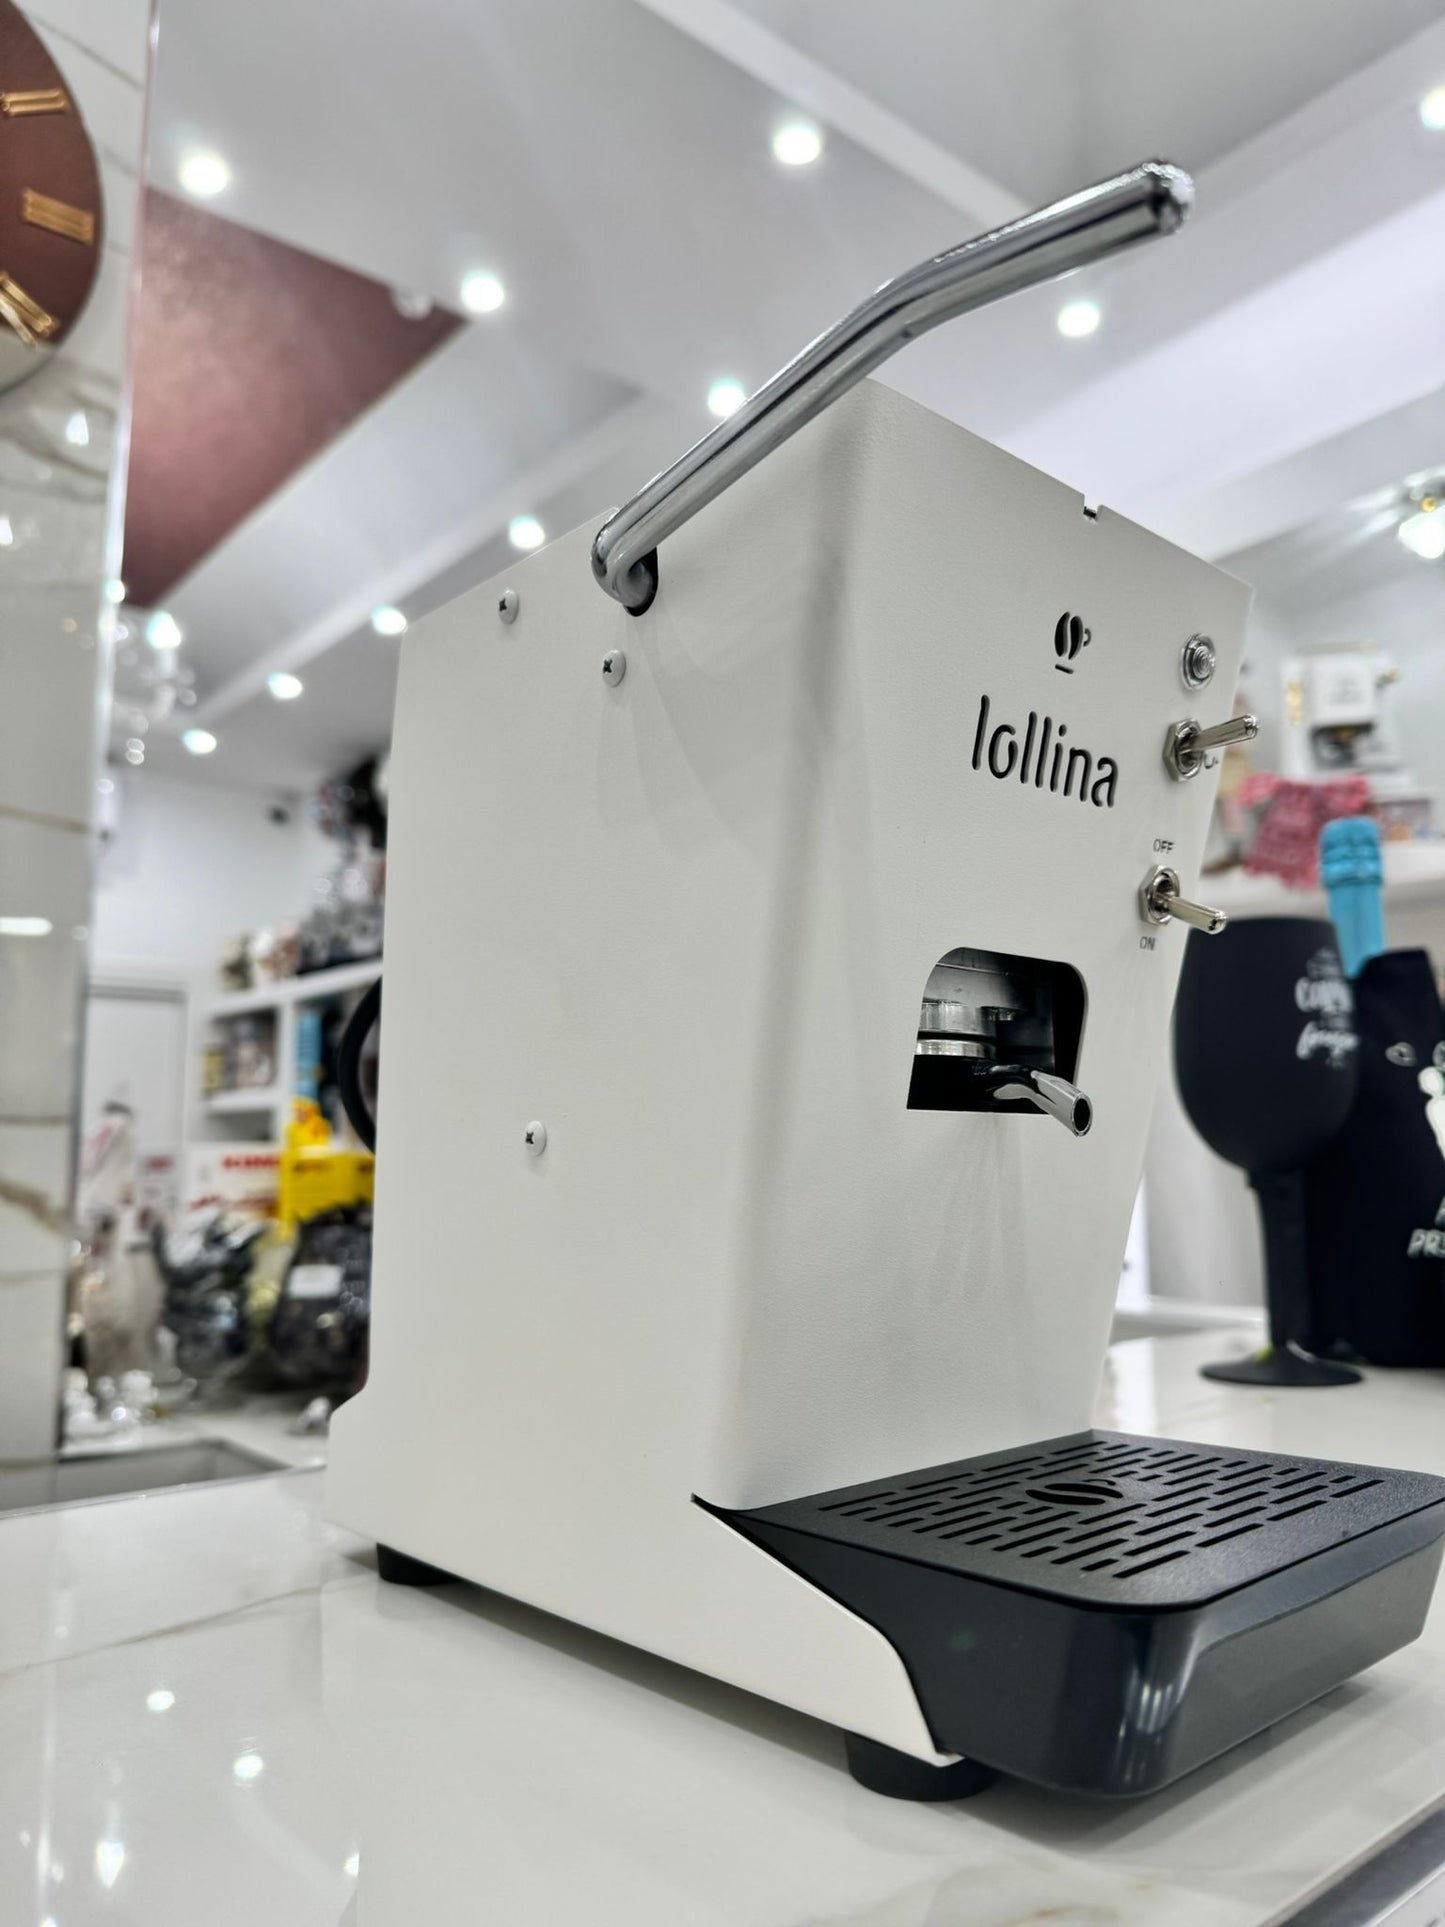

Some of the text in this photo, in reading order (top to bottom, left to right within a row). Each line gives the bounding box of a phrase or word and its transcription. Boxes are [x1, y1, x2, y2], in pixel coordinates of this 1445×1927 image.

[971, 694, 1119, 808] lollina
[1153, 839, 1174, 854] OFF
[1139, 936, 1156, 951] ON
